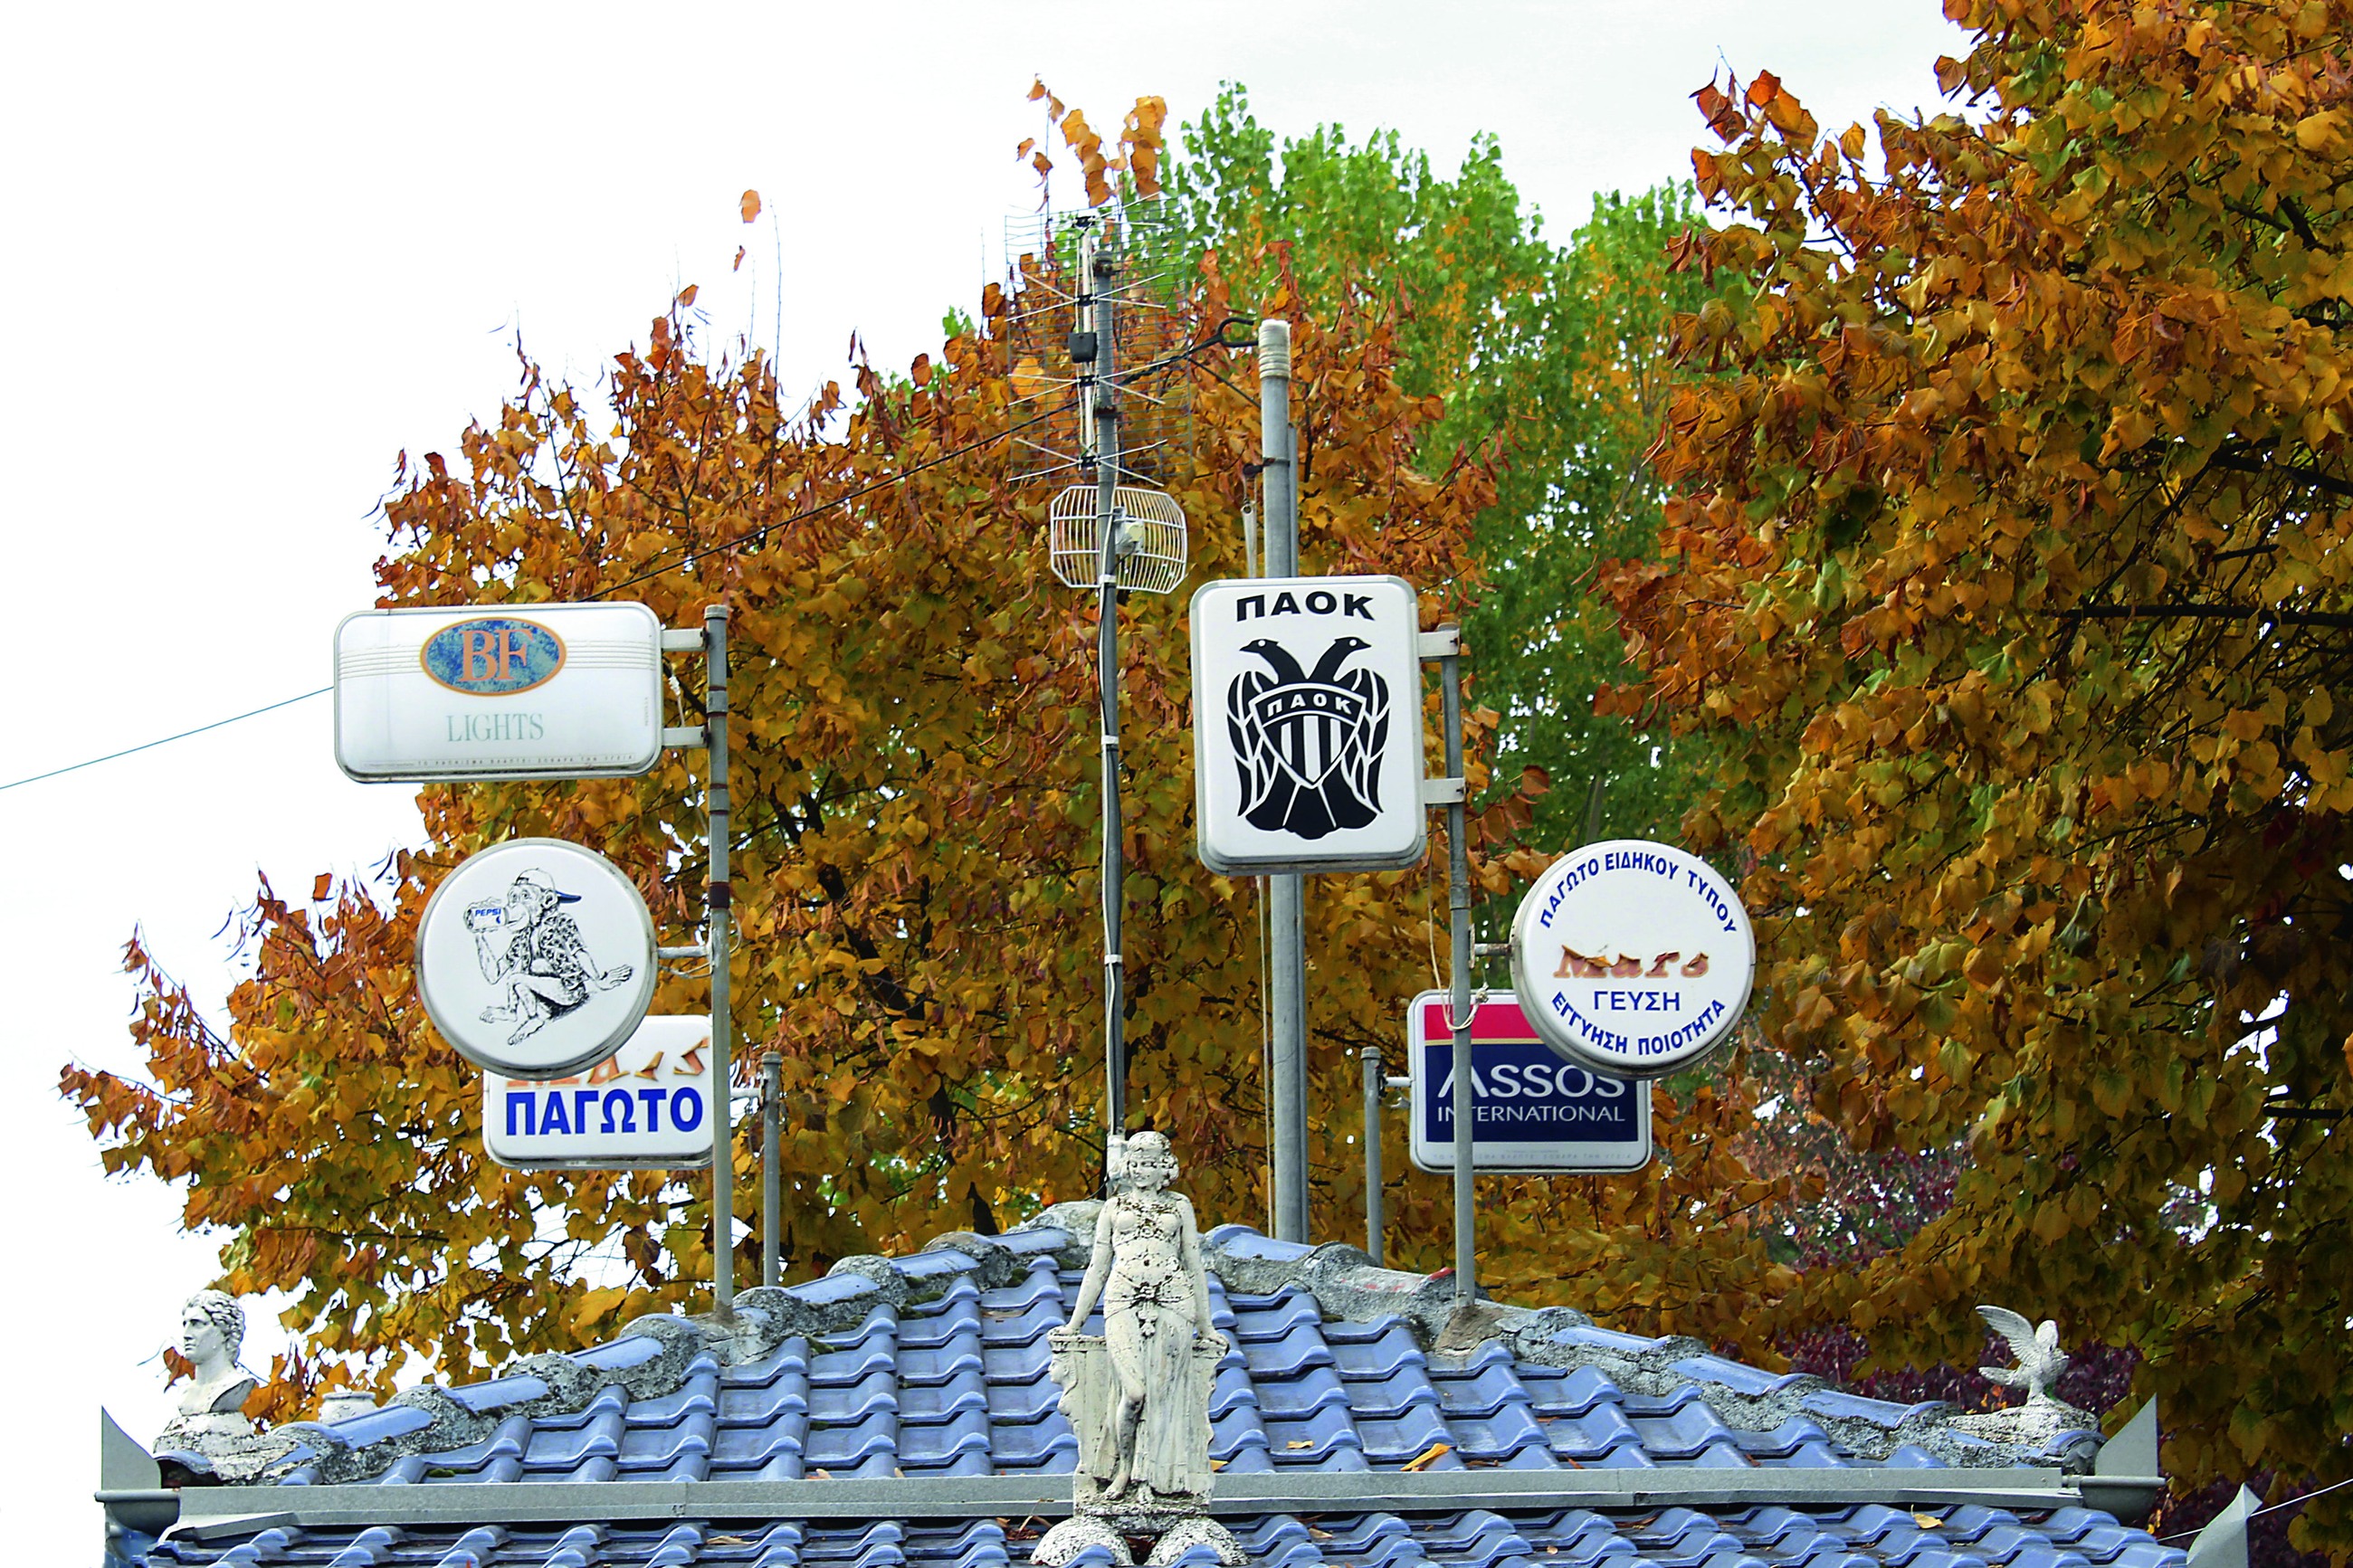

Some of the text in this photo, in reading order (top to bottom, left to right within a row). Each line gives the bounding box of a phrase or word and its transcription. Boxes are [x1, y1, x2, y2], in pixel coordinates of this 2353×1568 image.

[1236, 591, 1376, 622] ΠΑΟΚ
[457, 628, 536, 682] BF
[1267, 693, 1352, 717] ΠΑΟΚ
[446, 713, 545, 742] LIGHTS
[1539, 851, 1737, 933] ΠΑΓΩΤΟ ΕΙΔΗΚΟΥ ΤΥΠΟΥ
[475, 908, 501, 917] PEPSI
[1594, 991, 1681, 1012] ΓΕΥΣΗ
[1551, 991, 1726, 1056] ΕΓΓΥΗΣΗ ΠΟΙΟΤΗΤΑ
[506, 1087, 703, 1136] ΠΑΓΩΤΟ
[1437, 1106, 1625, 1122] INERNATIONAL
